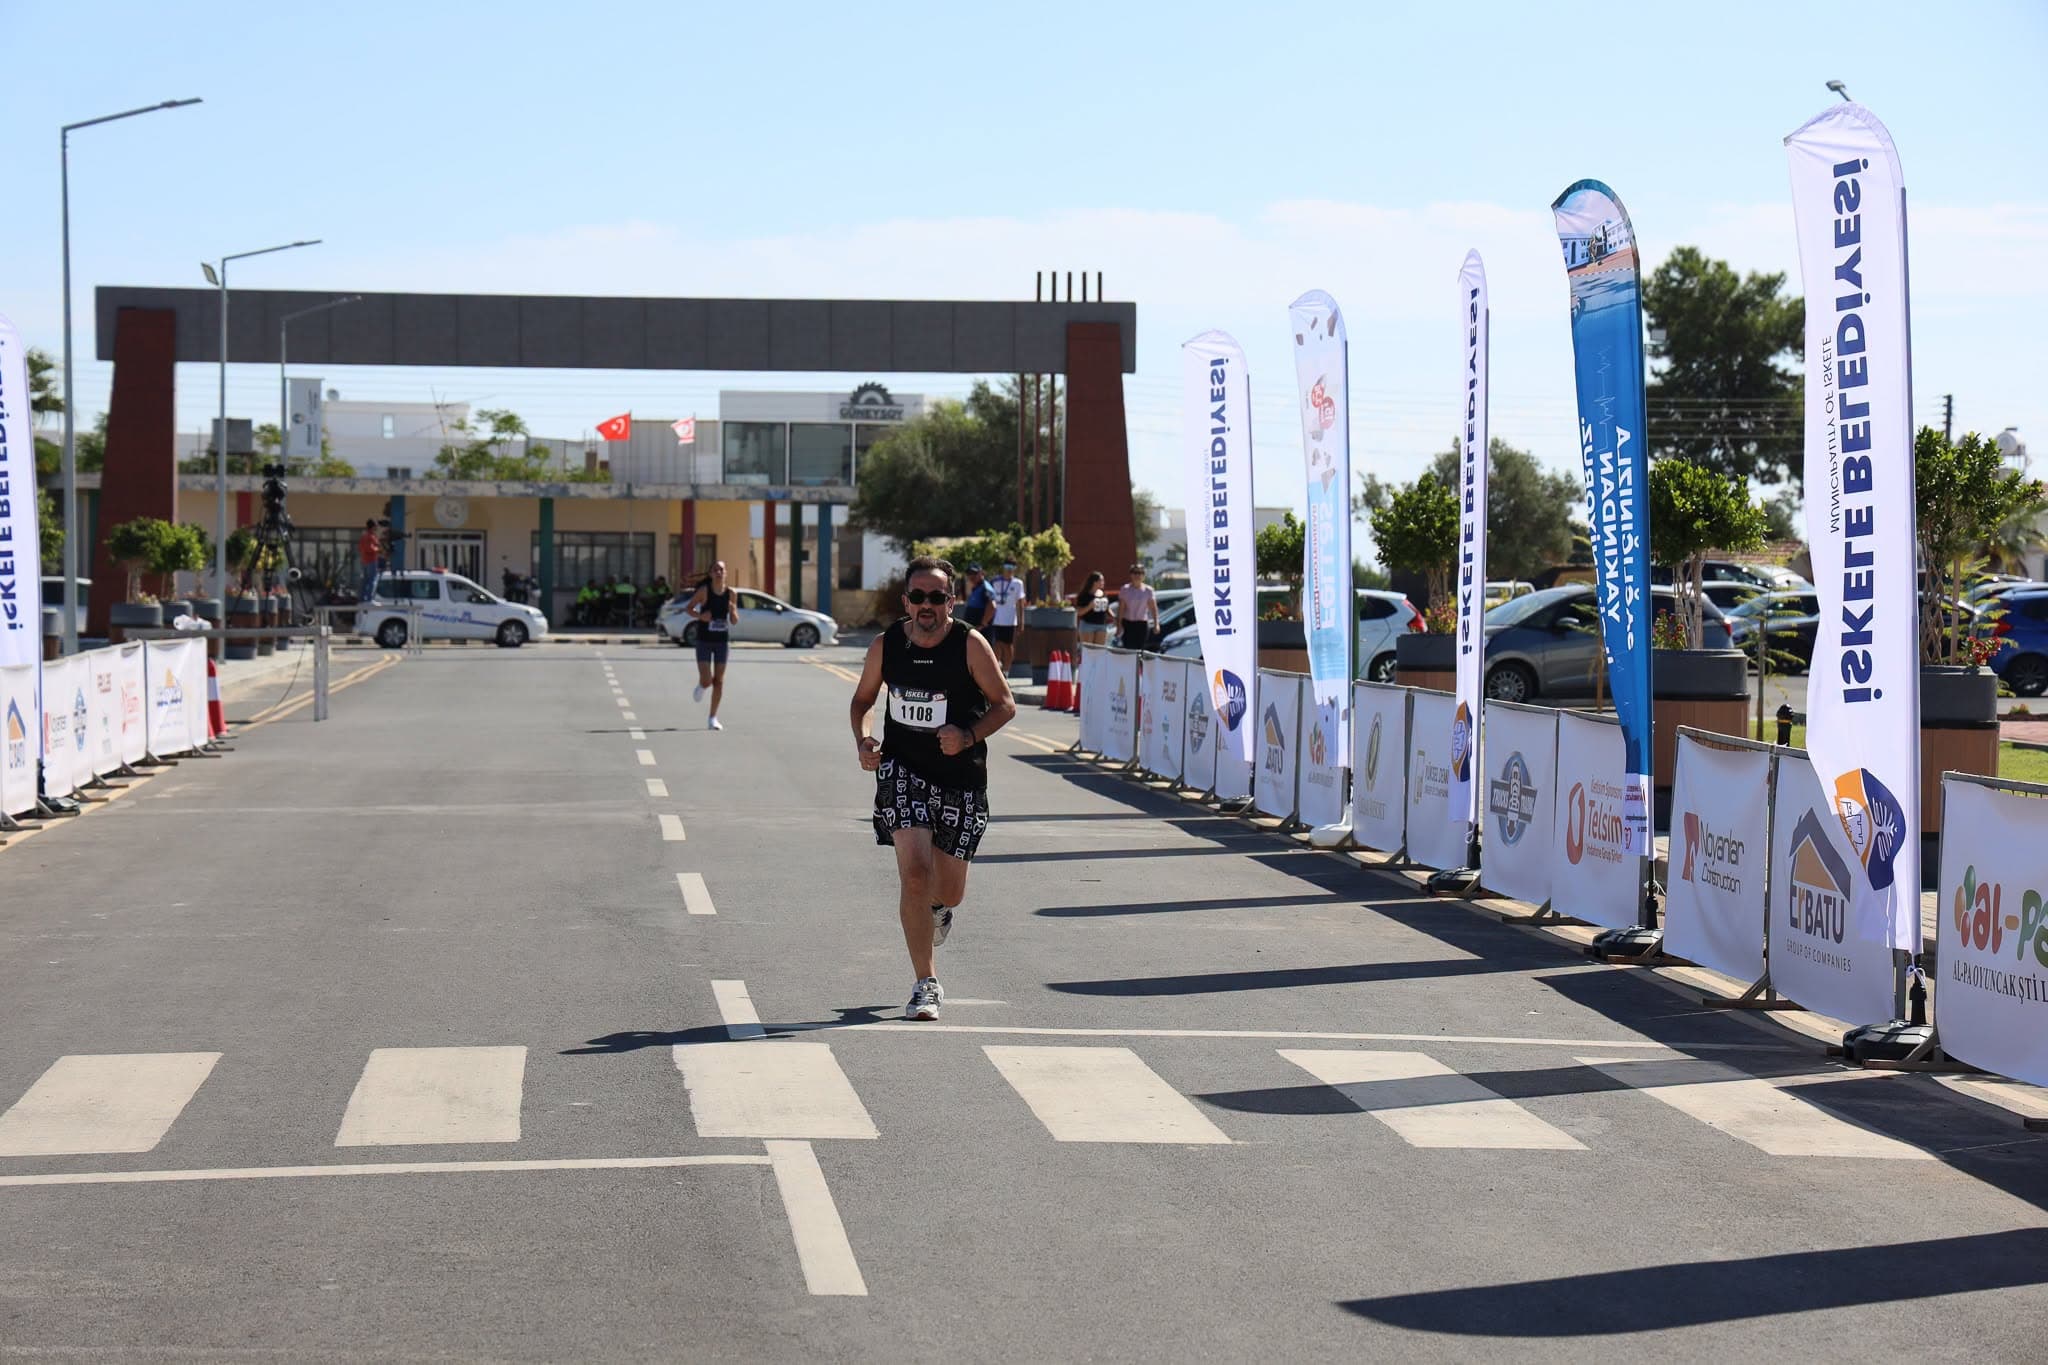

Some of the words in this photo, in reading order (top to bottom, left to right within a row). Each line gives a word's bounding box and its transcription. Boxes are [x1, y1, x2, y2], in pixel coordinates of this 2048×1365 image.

[902, 704, 933, 722] 1108
[1588, 799, 1622, 845] Telsim
[1700, 820, 1745, 867] Noyanlar
[1702, 862, 1741, 895] Construction
[1786, 938, 1804, 957] GROUP
[1804, 944, 1811, 960] OF
[1812, 949, 1852, 973] COMPANIES
[1973, 964, 2017, 997] OYUNCAK
